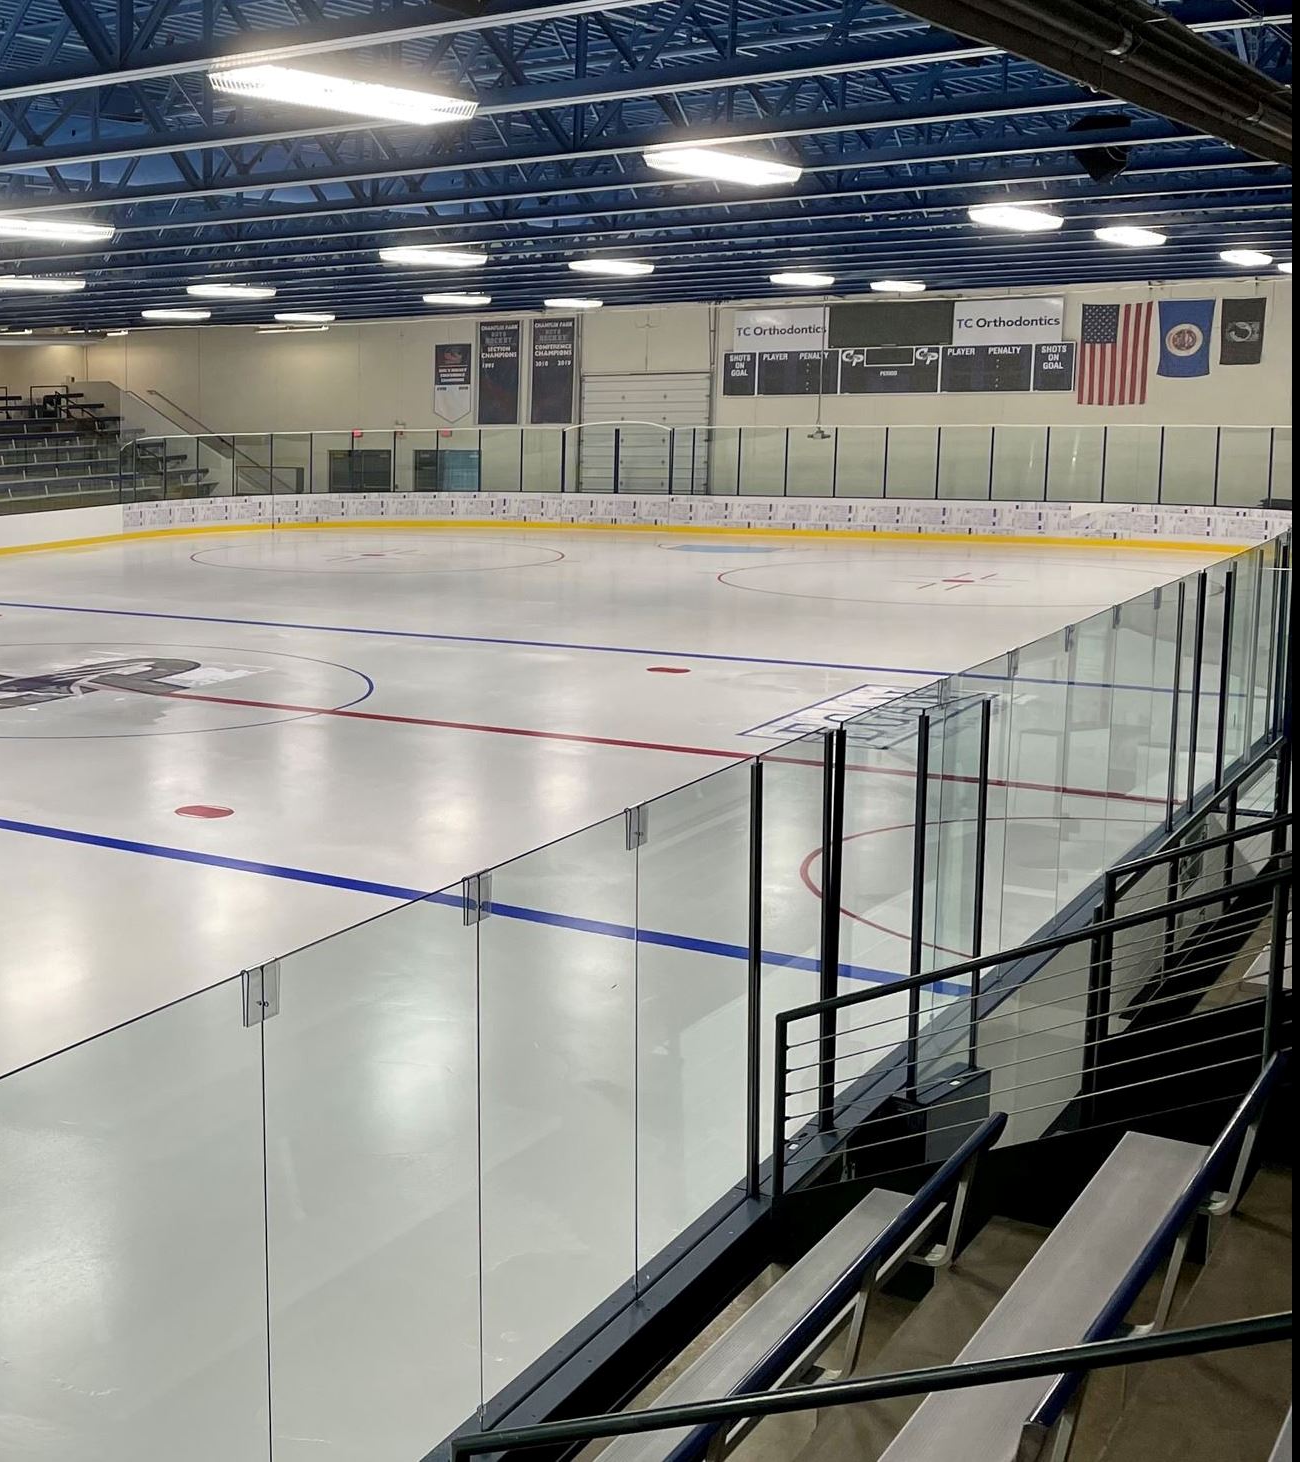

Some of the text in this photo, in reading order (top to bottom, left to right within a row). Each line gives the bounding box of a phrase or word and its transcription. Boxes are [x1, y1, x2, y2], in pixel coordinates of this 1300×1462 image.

[956, 315, 1060, 329] TC Orthodontics
[736, 324, 827, 336] TC Orthodontics
[947, 347, 976, 356] PLAYER
[988, 346, 1022, 355] PENALTY
[1041, 345, 1067, 353] SHOTS
[481, 351, 517, 359] CHAMPIONS
[729, 354, 751, 362] SHOTS
[763, 353, 788, 361] PLAYER
[1048, 353, 1059, 361] ON
[1043, 361, 1063, 370] GOAL
[730, 369, 748, 377] GOAL
